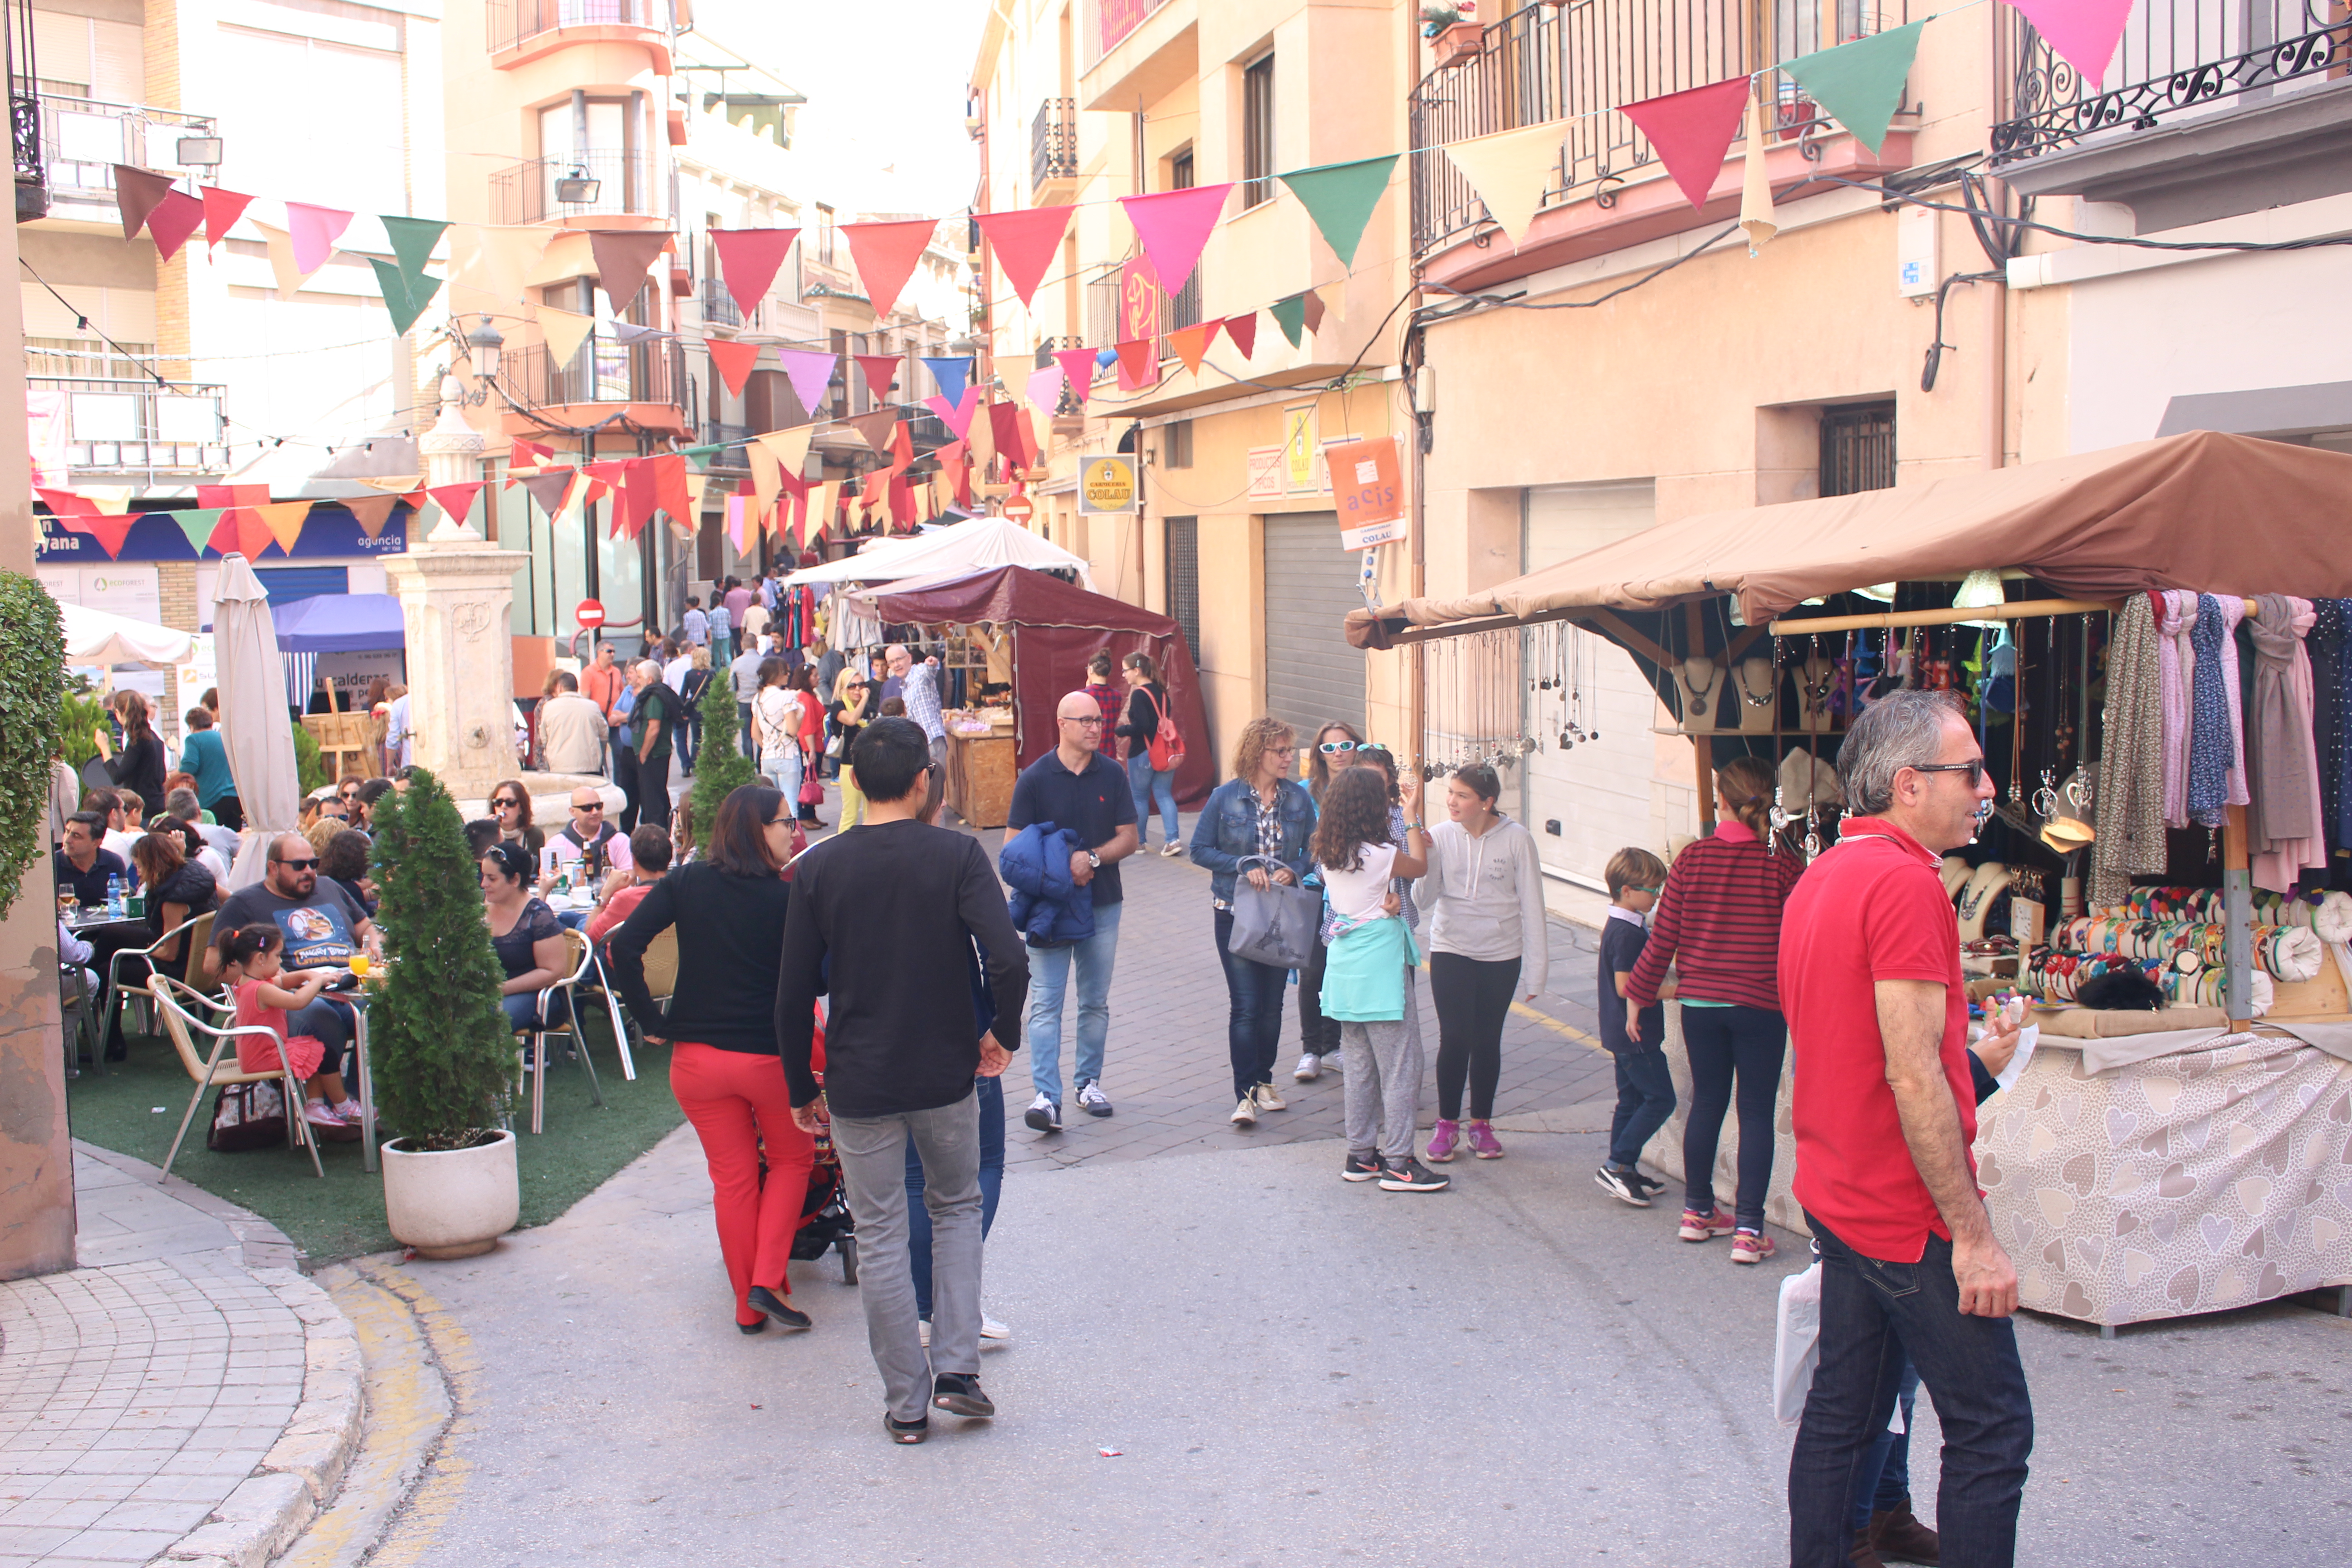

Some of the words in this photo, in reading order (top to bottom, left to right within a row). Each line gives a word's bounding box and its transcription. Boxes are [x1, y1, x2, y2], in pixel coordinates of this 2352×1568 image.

[1249, 456, 1281, 470] PRODUCTOS
[1291, 458, 1308, 472] COLAU
[1086, 489, 1130, 500] COLAU
[1347, 486, 1395, 511] acis
[1362, 531, 1392, 543] COLAU
[299, 947, 327, 960] ANGRY
